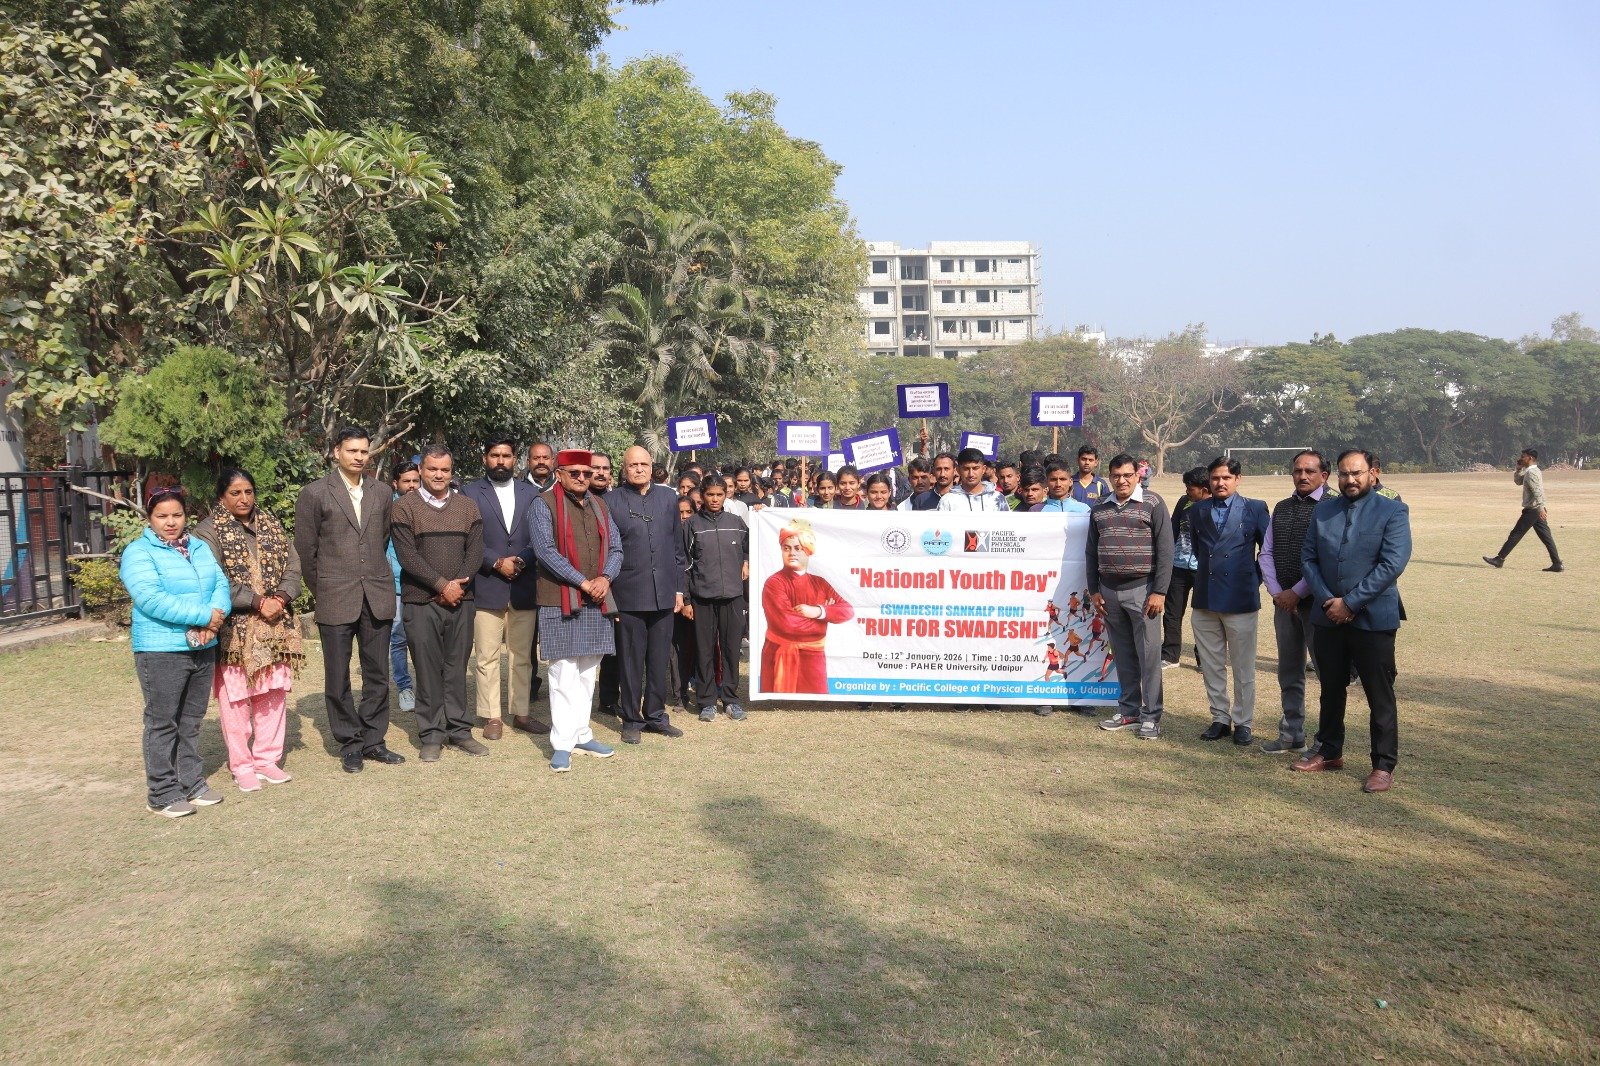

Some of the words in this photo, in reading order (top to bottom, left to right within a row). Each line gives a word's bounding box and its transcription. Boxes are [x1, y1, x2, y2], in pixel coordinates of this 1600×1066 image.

[850, 567, 945, 589] "National
[949, 569, 1006, 590] Youth
[1010, 570, 1057, 593] Day"
[880, 603, 944, 616] (SWADESHI
[945, 604, 996, 617] SANKALP
[997, 605, 1025, 618] RUN)
[857, 617, 902, 637] "RUN
[906, 619, 940, 637] FOR
[944, 619, 1047, 639] SWADESHI"
[862, 651, 883, 660] Date
[905, 652, 942, 662] January,
[943, 653, 963, 661] 2026
[971, 653, 993, 662] Time
[999, 654, 1021, 662] 10:30
[1023, 654, 1039, 662] AM
[910, 662, 943, 671] PAHER
[946, 663, 989, 672] University,
[991, 664, 1024, 673] Udaipur
[834, 681, 877, 691] Organize
[880, 681, 890, 692] by
[899, 682, 932, 692] Pacific
[934, 683, 968, 694] College
[970, 683, 981, 692] of
[983, 683, 1023, 694] Physical
[1026, 684, 1077, 695] Education,
[1080, 686, 1118, 697] Udaipur
